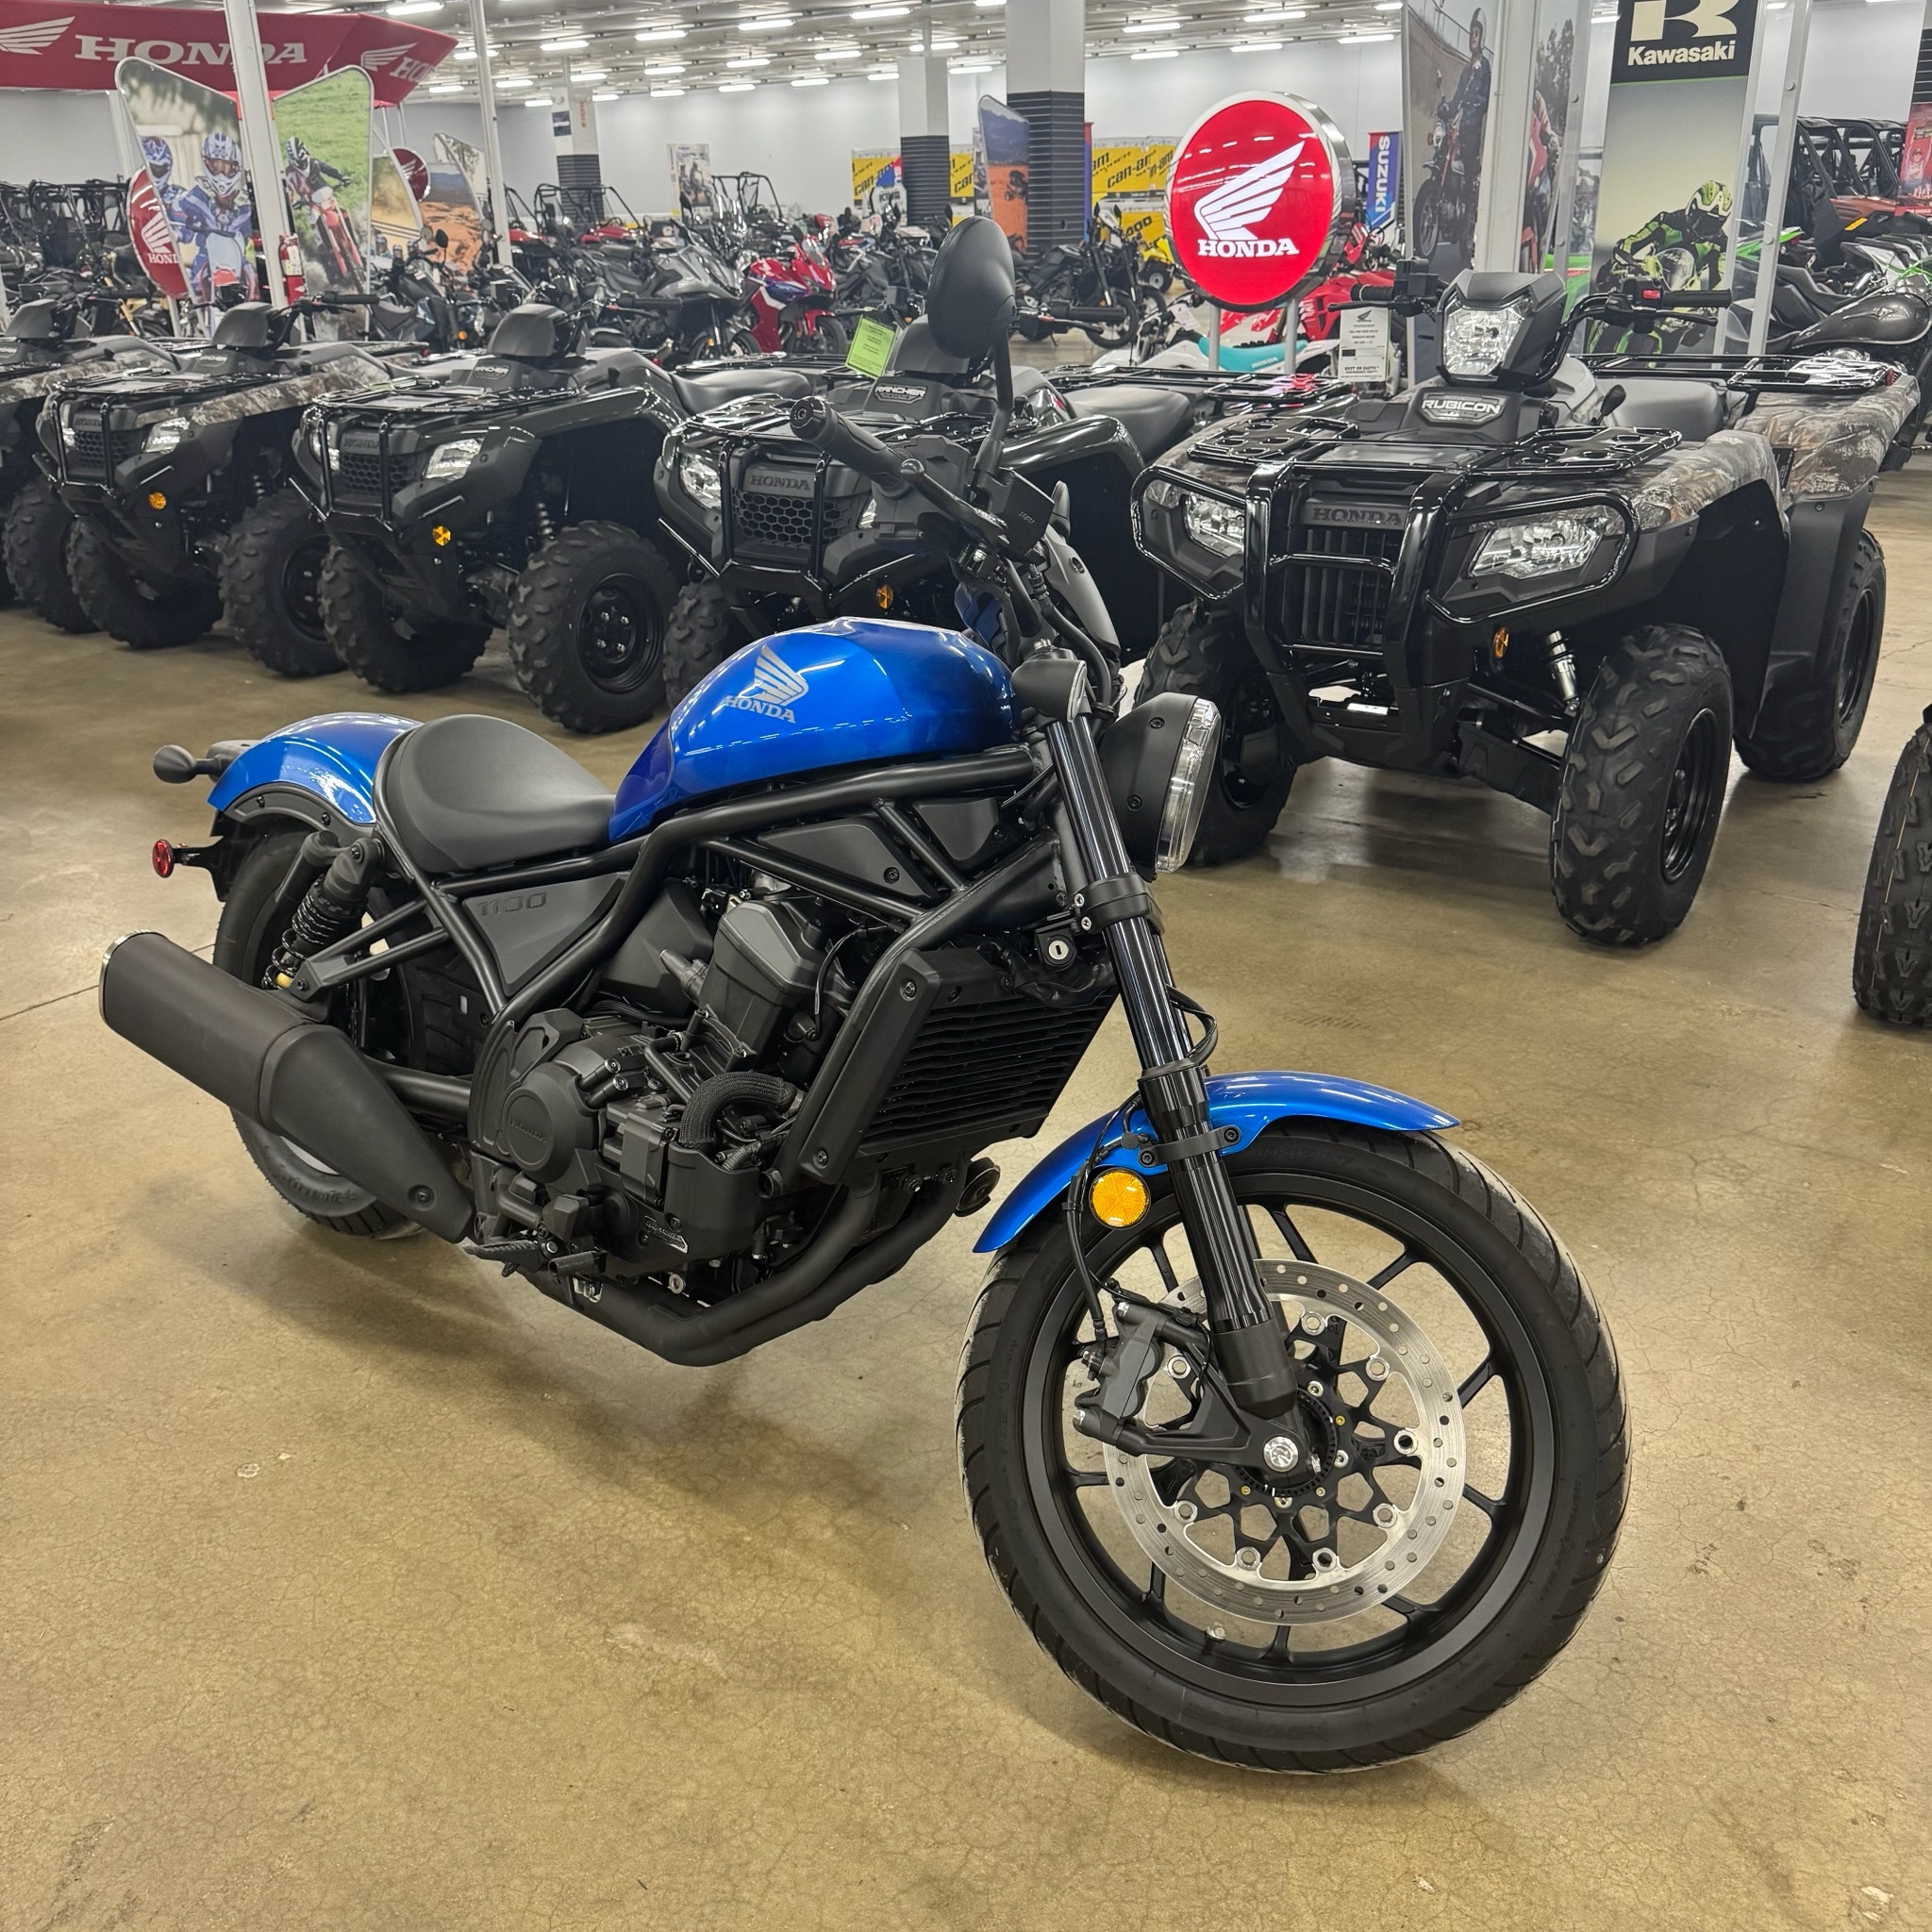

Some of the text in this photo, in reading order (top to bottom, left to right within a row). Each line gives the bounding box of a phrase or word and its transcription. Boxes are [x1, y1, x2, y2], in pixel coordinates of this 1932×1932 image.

[75, 34, 308, 65] HONA
[1627, 40, 1736, 66] Kawasaki
[1374, 135, 1391, 212] SUZUKI
[1197, 238, 1301, 258] HONDA
[874, 386, 926, 397] RANCHER
[1422, 399, 1501, 414] RUBICON
[750, 475, 811, 491] HONDA
[1312, 508, 1405, 526] HONDA
[724, 695, 796, 724] HONDA
[477, 891, 547, 916] 1100
